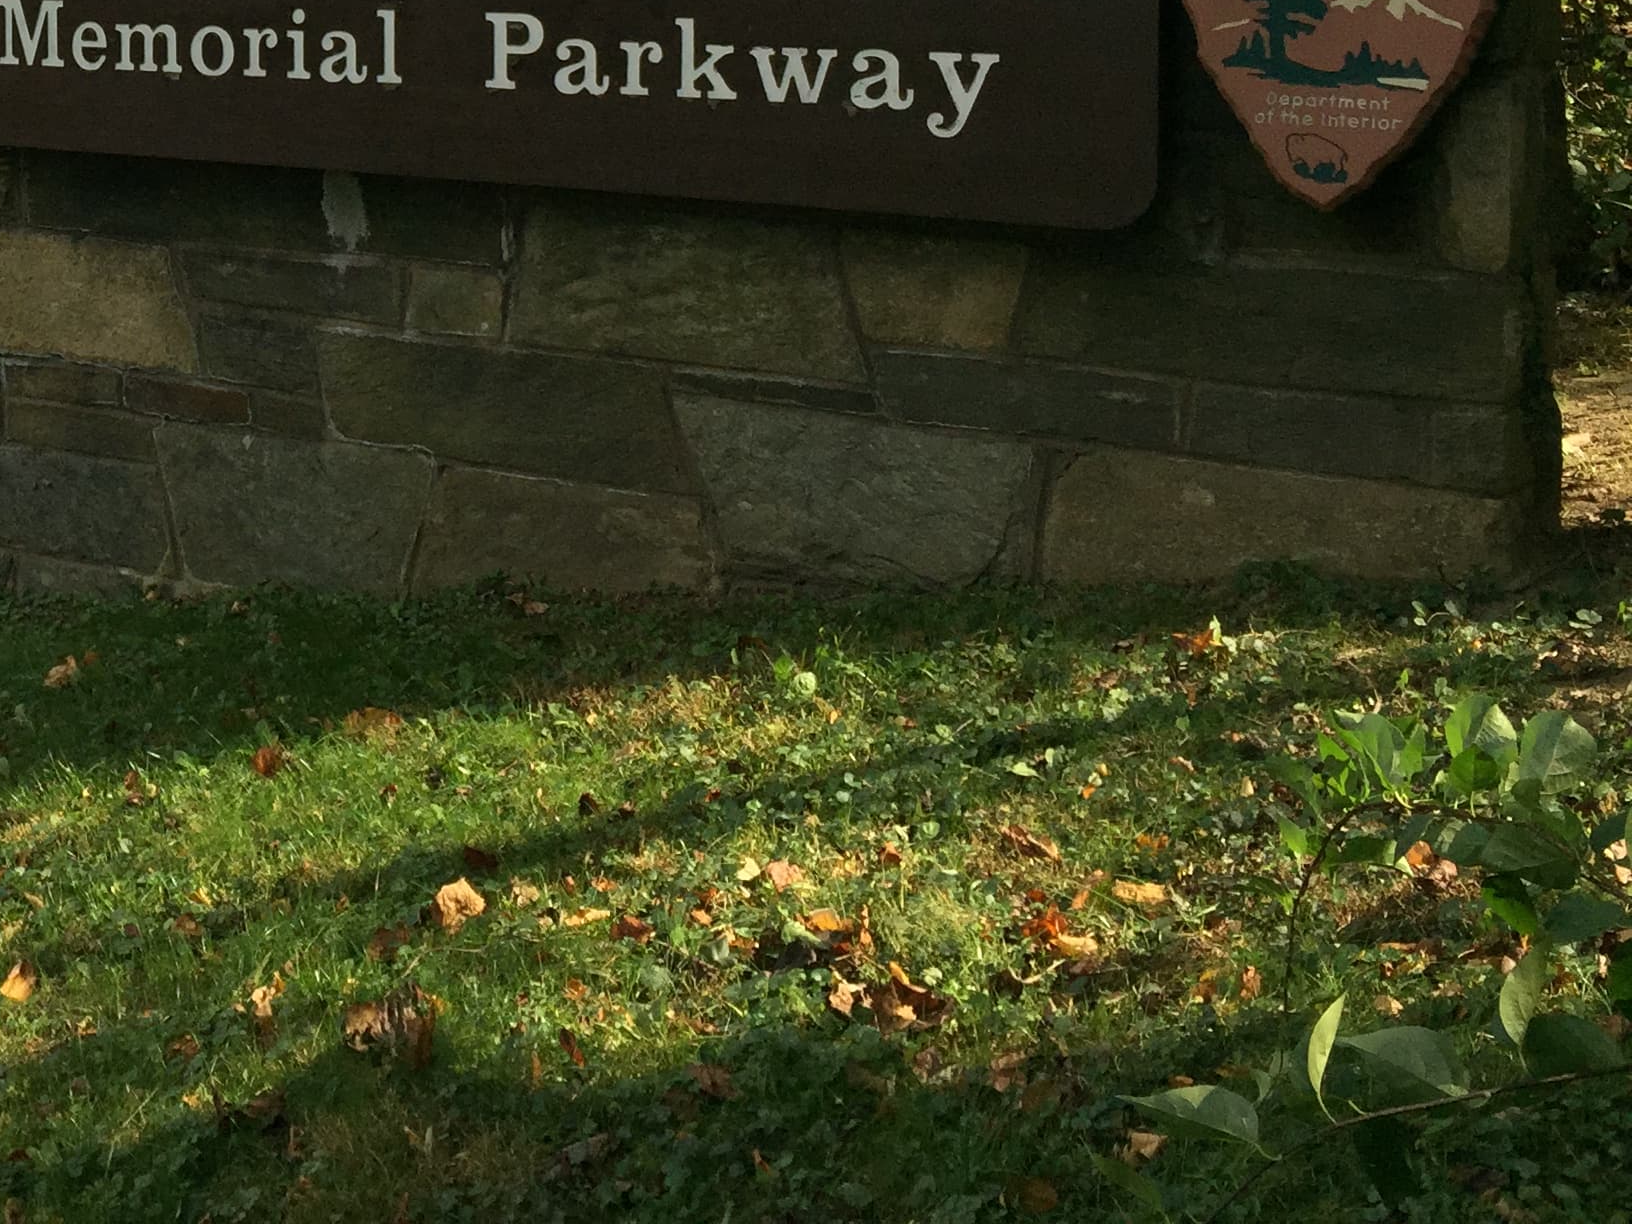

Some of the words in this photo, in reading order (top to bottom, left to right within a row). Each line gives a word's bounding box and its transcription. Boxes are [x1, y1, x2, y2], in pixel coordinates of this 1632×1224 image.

[484, 11, 1002, 139] Parkway
[1266, 91, 1390, 111] Department
[1254, 108, 1275, 125] of
[1279, 108, 1314, 126] the
